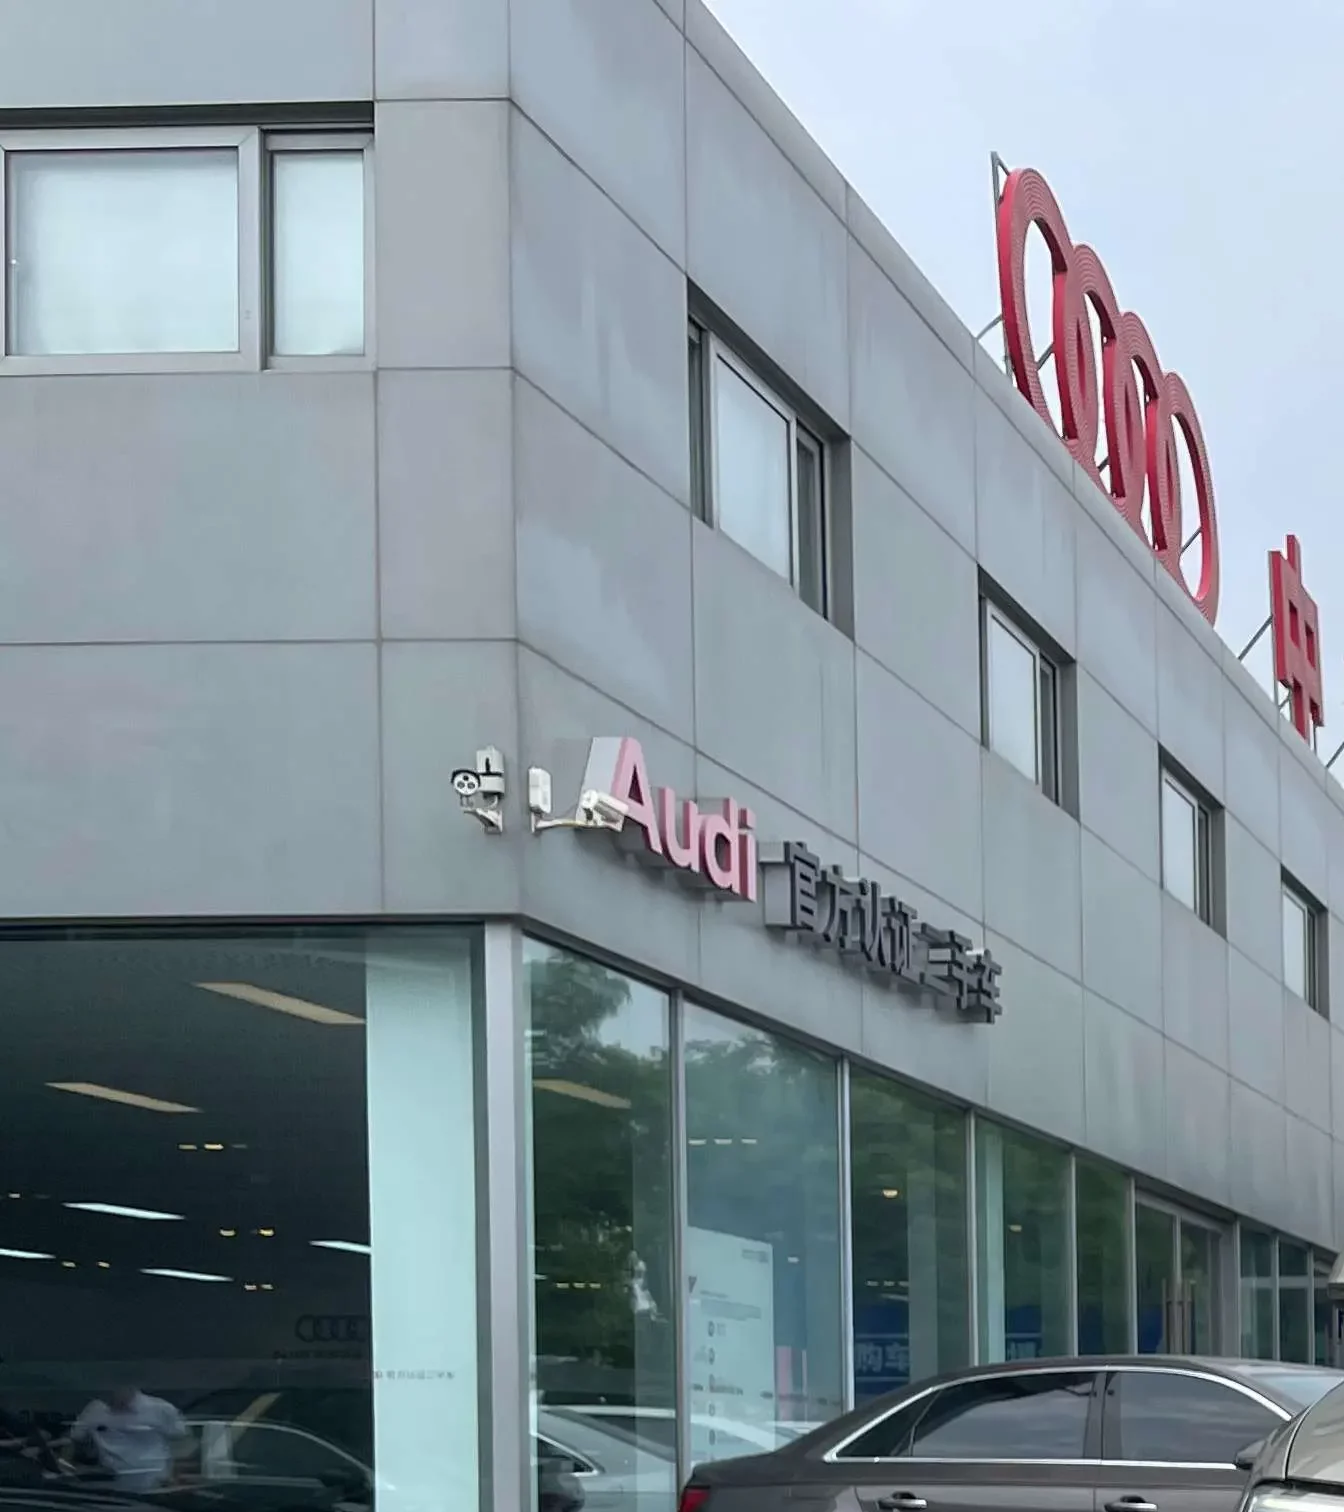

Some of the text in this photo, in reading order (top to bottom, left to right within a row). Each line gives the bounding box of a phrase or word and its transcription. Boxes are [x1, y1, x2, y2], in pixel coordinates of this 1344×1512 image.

[586, 735, 1002, 1024] Audi 官方认证二手车
